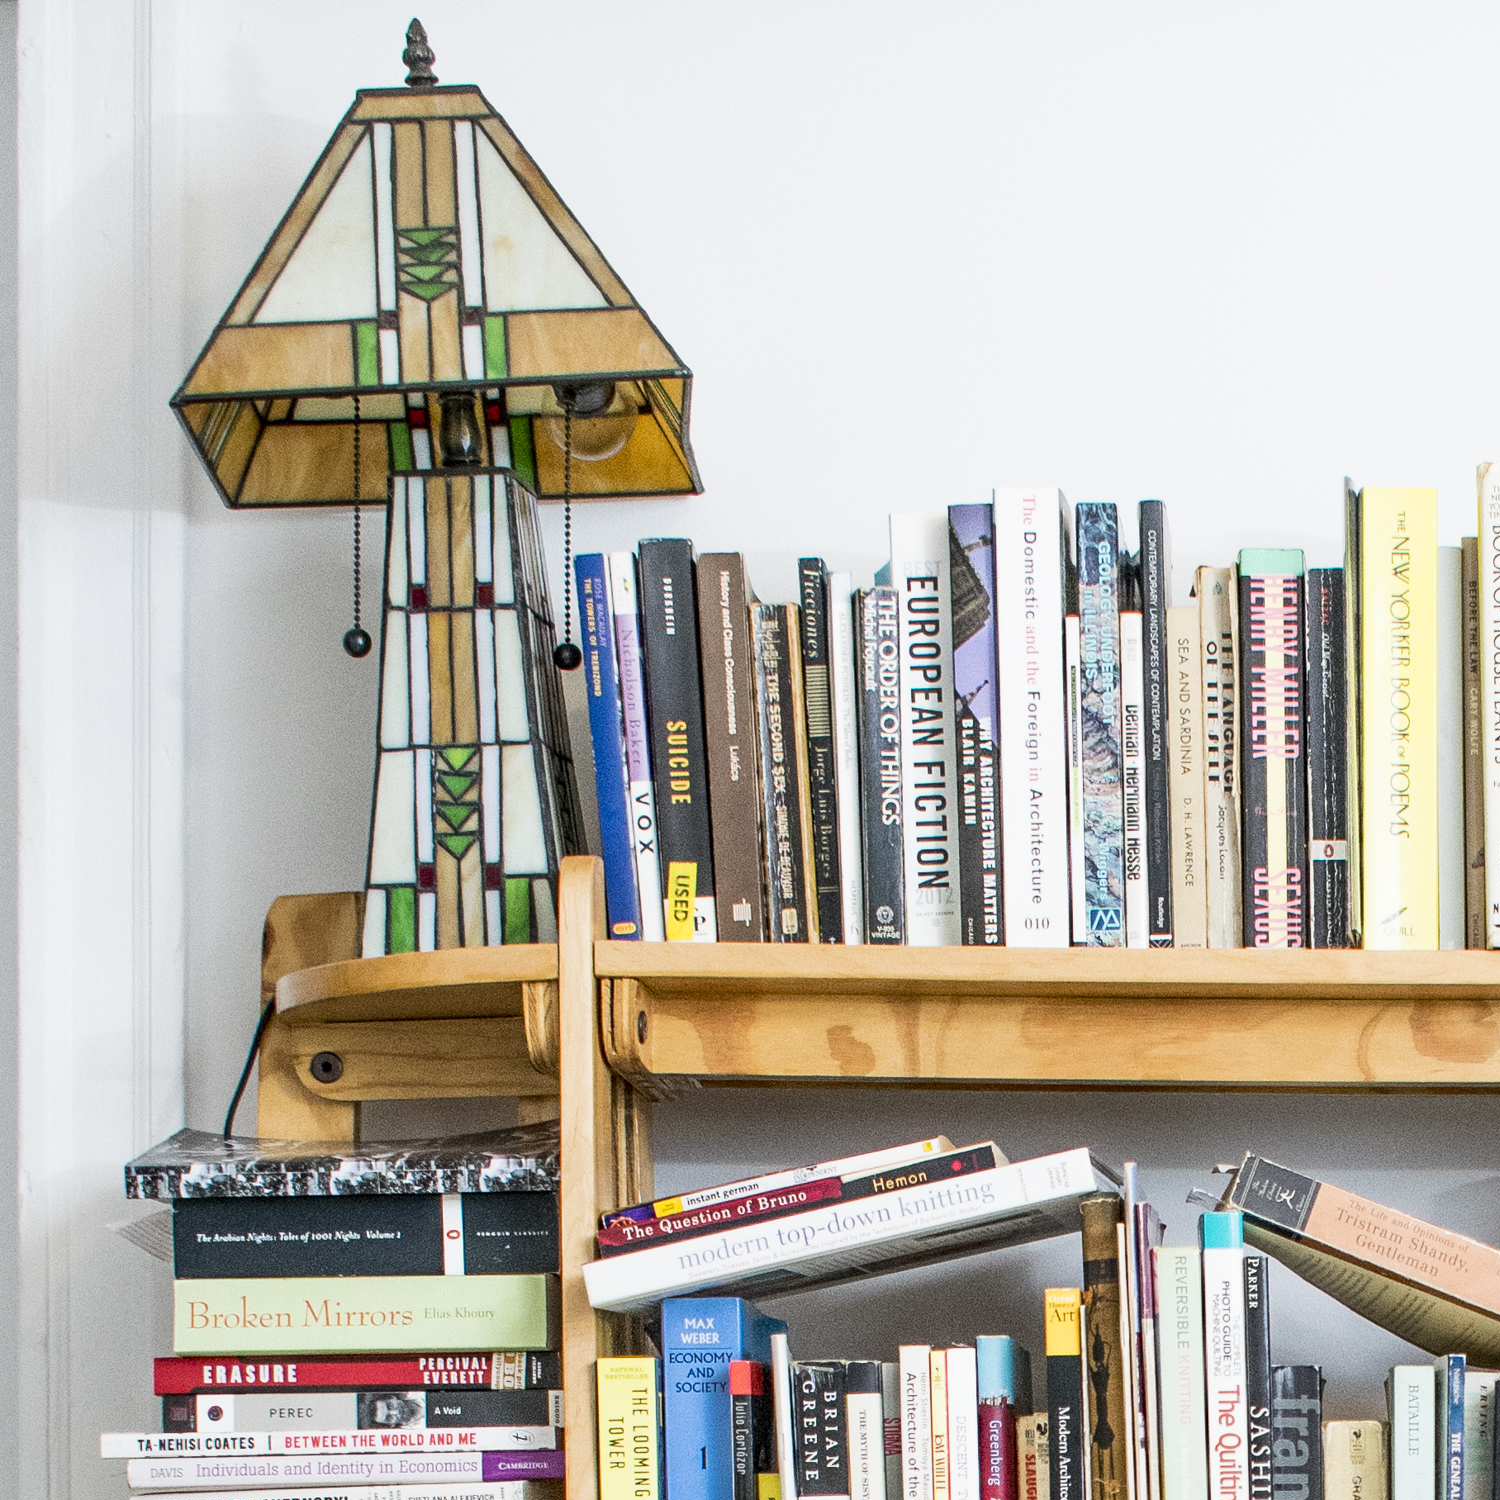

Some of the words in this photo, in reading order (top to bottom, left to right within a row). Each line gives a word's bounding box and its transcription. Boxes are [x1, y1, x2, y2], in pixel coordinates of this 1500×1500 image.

[1022, 495, 1035, 525] The
[1397, 511, 1405, 532] THE
[1022, 531, 1037, 619] Domestic
[1391, 537, 1410, 584] NEW
[804, 569, 819, 659] Ficciones
[877, 595, 897, 637] THE
[1390, 590, 1410, 666] YORKER
[906, 575, 943, 747] EUROPEAN
[1025, 630, 1037, 659] and
[879, 640, 898, 710] ORDER
[1027, 665, 1037, 685] the
[880, 713, 899, 744] OF
[1025, 692, 1041, 761] Foreign
[1391, 678, 1410, 743] BOOK
[667, 721, 691, 805] SUICIDE
[1029, 767, 1038, 782] in
[1397, 746, 1405, 759] OF
[881, 749, 900, 826] THINGS
[1390, 764, 1410, 838] POEMS
[635, 792, 656, 855] VOX
[915, 761, 951, 890] FICTION
[1030, 789, 1042, 904] Architecture
[674, 874, 690, 923] USED
[623, 1225, 653, 1241] The
[660, 1206, 731, 1234] Question
[737, 1200, 752, 1215] of
[759, 1192, 807, 1211] Bruno
[873, 1170, 927, 1191] Hemon
[687, 1191, 720, 1206] instant
[723, 1182, 759, 1198] german
[678, 1235, 769, 1269] modern
[776, 1208, 892, 1245] top-down
[900, 1180, 996, 1217] knitting
[187, 1297, 293, 1329] Broken
[303, 1299, 413, 1327] Mirrors
[424, 1307, 451, 1319] Elias
[455, 1306, 496, 1320] Khoury
[685, 1318, 714, 1330] MAX
[669, 1352, 733, 1365] ECONOMY
[680, 1332, 720, 1344] WEBER
[203, 1365, 297, 1384] ERASURE
[676, 1381, 728, 1394] SOCIETY
[687, 1367, 714, 1379] AND
[269, 1408, 314, 1418] PEREC
[1218, 1386, 1240, 1432] The
[137, 1438, 201, 1452] TA-NEHISI
[204, 1436, 255, 1450] COATES
[284, 1434, 346, 1449] BETWEEN
[351, 1434, 376, 1448] THE
[381, 1433, 424, 1447] WORLD
[429, 1433, 454, 1446] AND
[459, 1433, 477, 1445] ME
